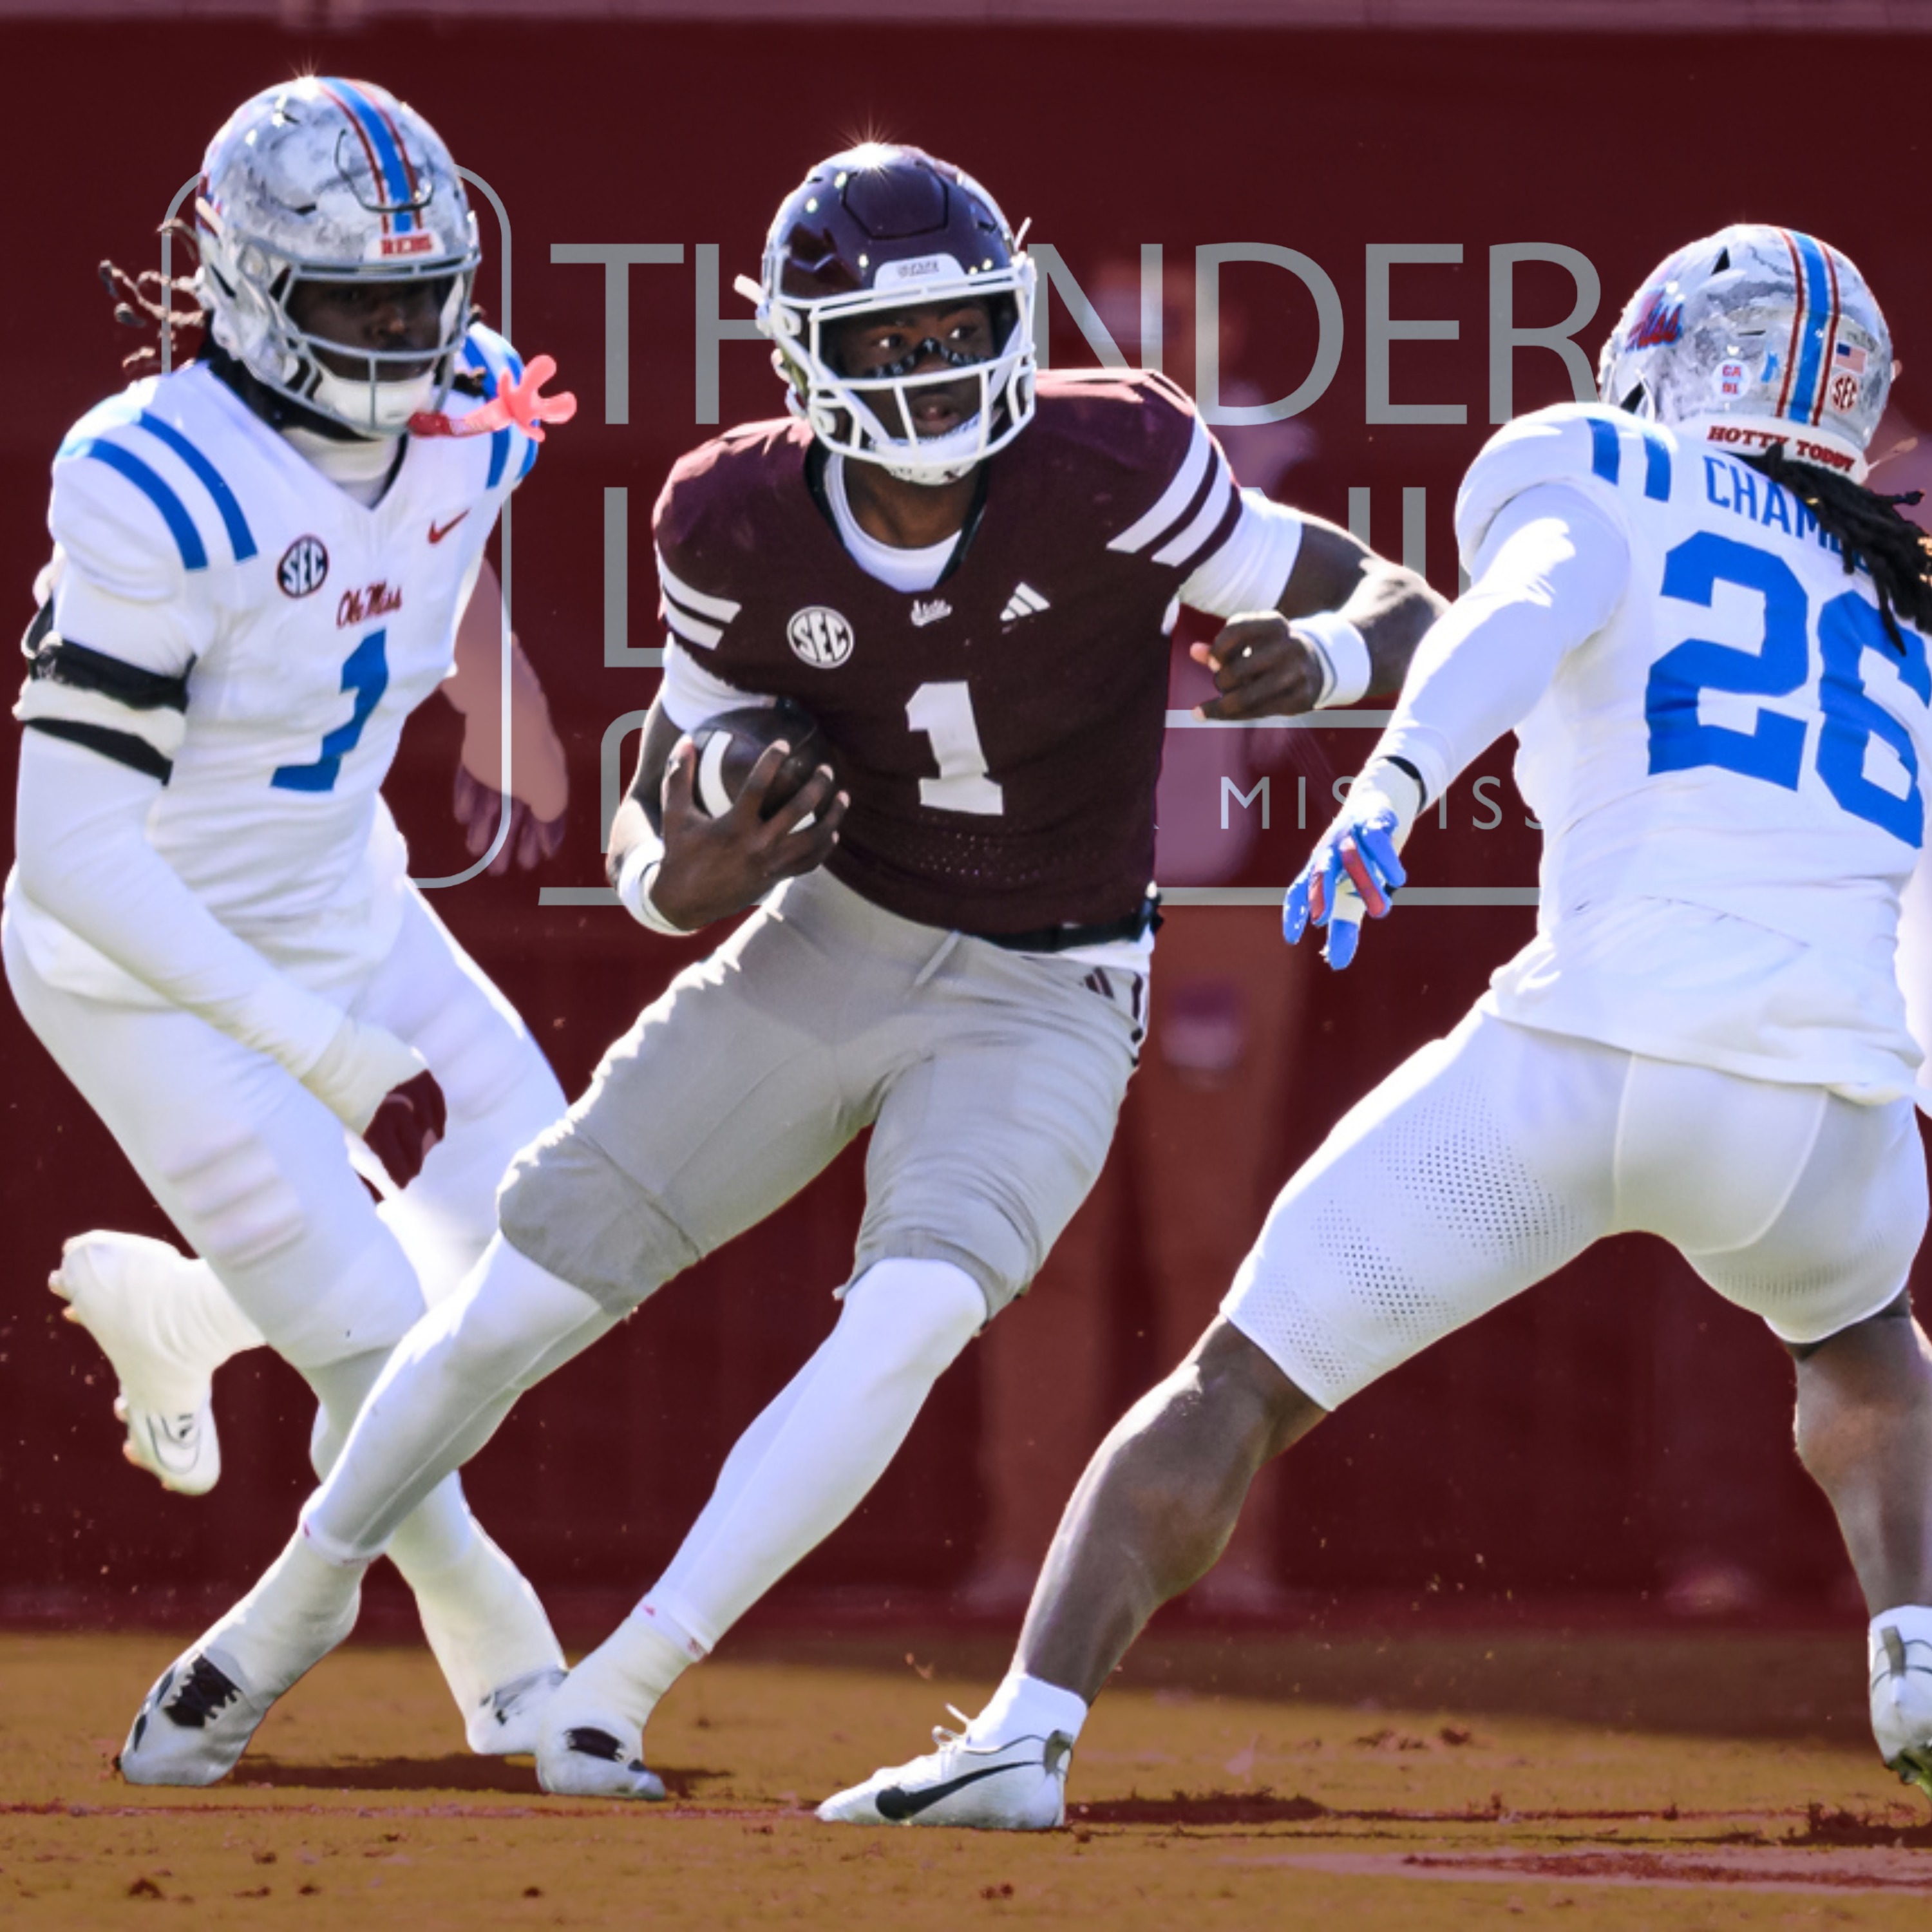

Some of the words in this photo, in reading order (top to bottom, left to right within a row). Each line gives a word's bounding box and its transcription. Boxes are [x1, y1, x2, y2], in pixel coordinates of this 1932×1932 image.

[1707, 426, 1789, 449] HOTTY
[1796, 439, 1855, 472] TODDY
[281, 538, 325, 596] SEC
[1702, 455, 1871, 575] CHAM
[792, 610, 848, 662] SEC
[1645, 530, 1931, 849] 26
[270, 629, 390, 791] 1
[905, 681, 1003, 816] 1
